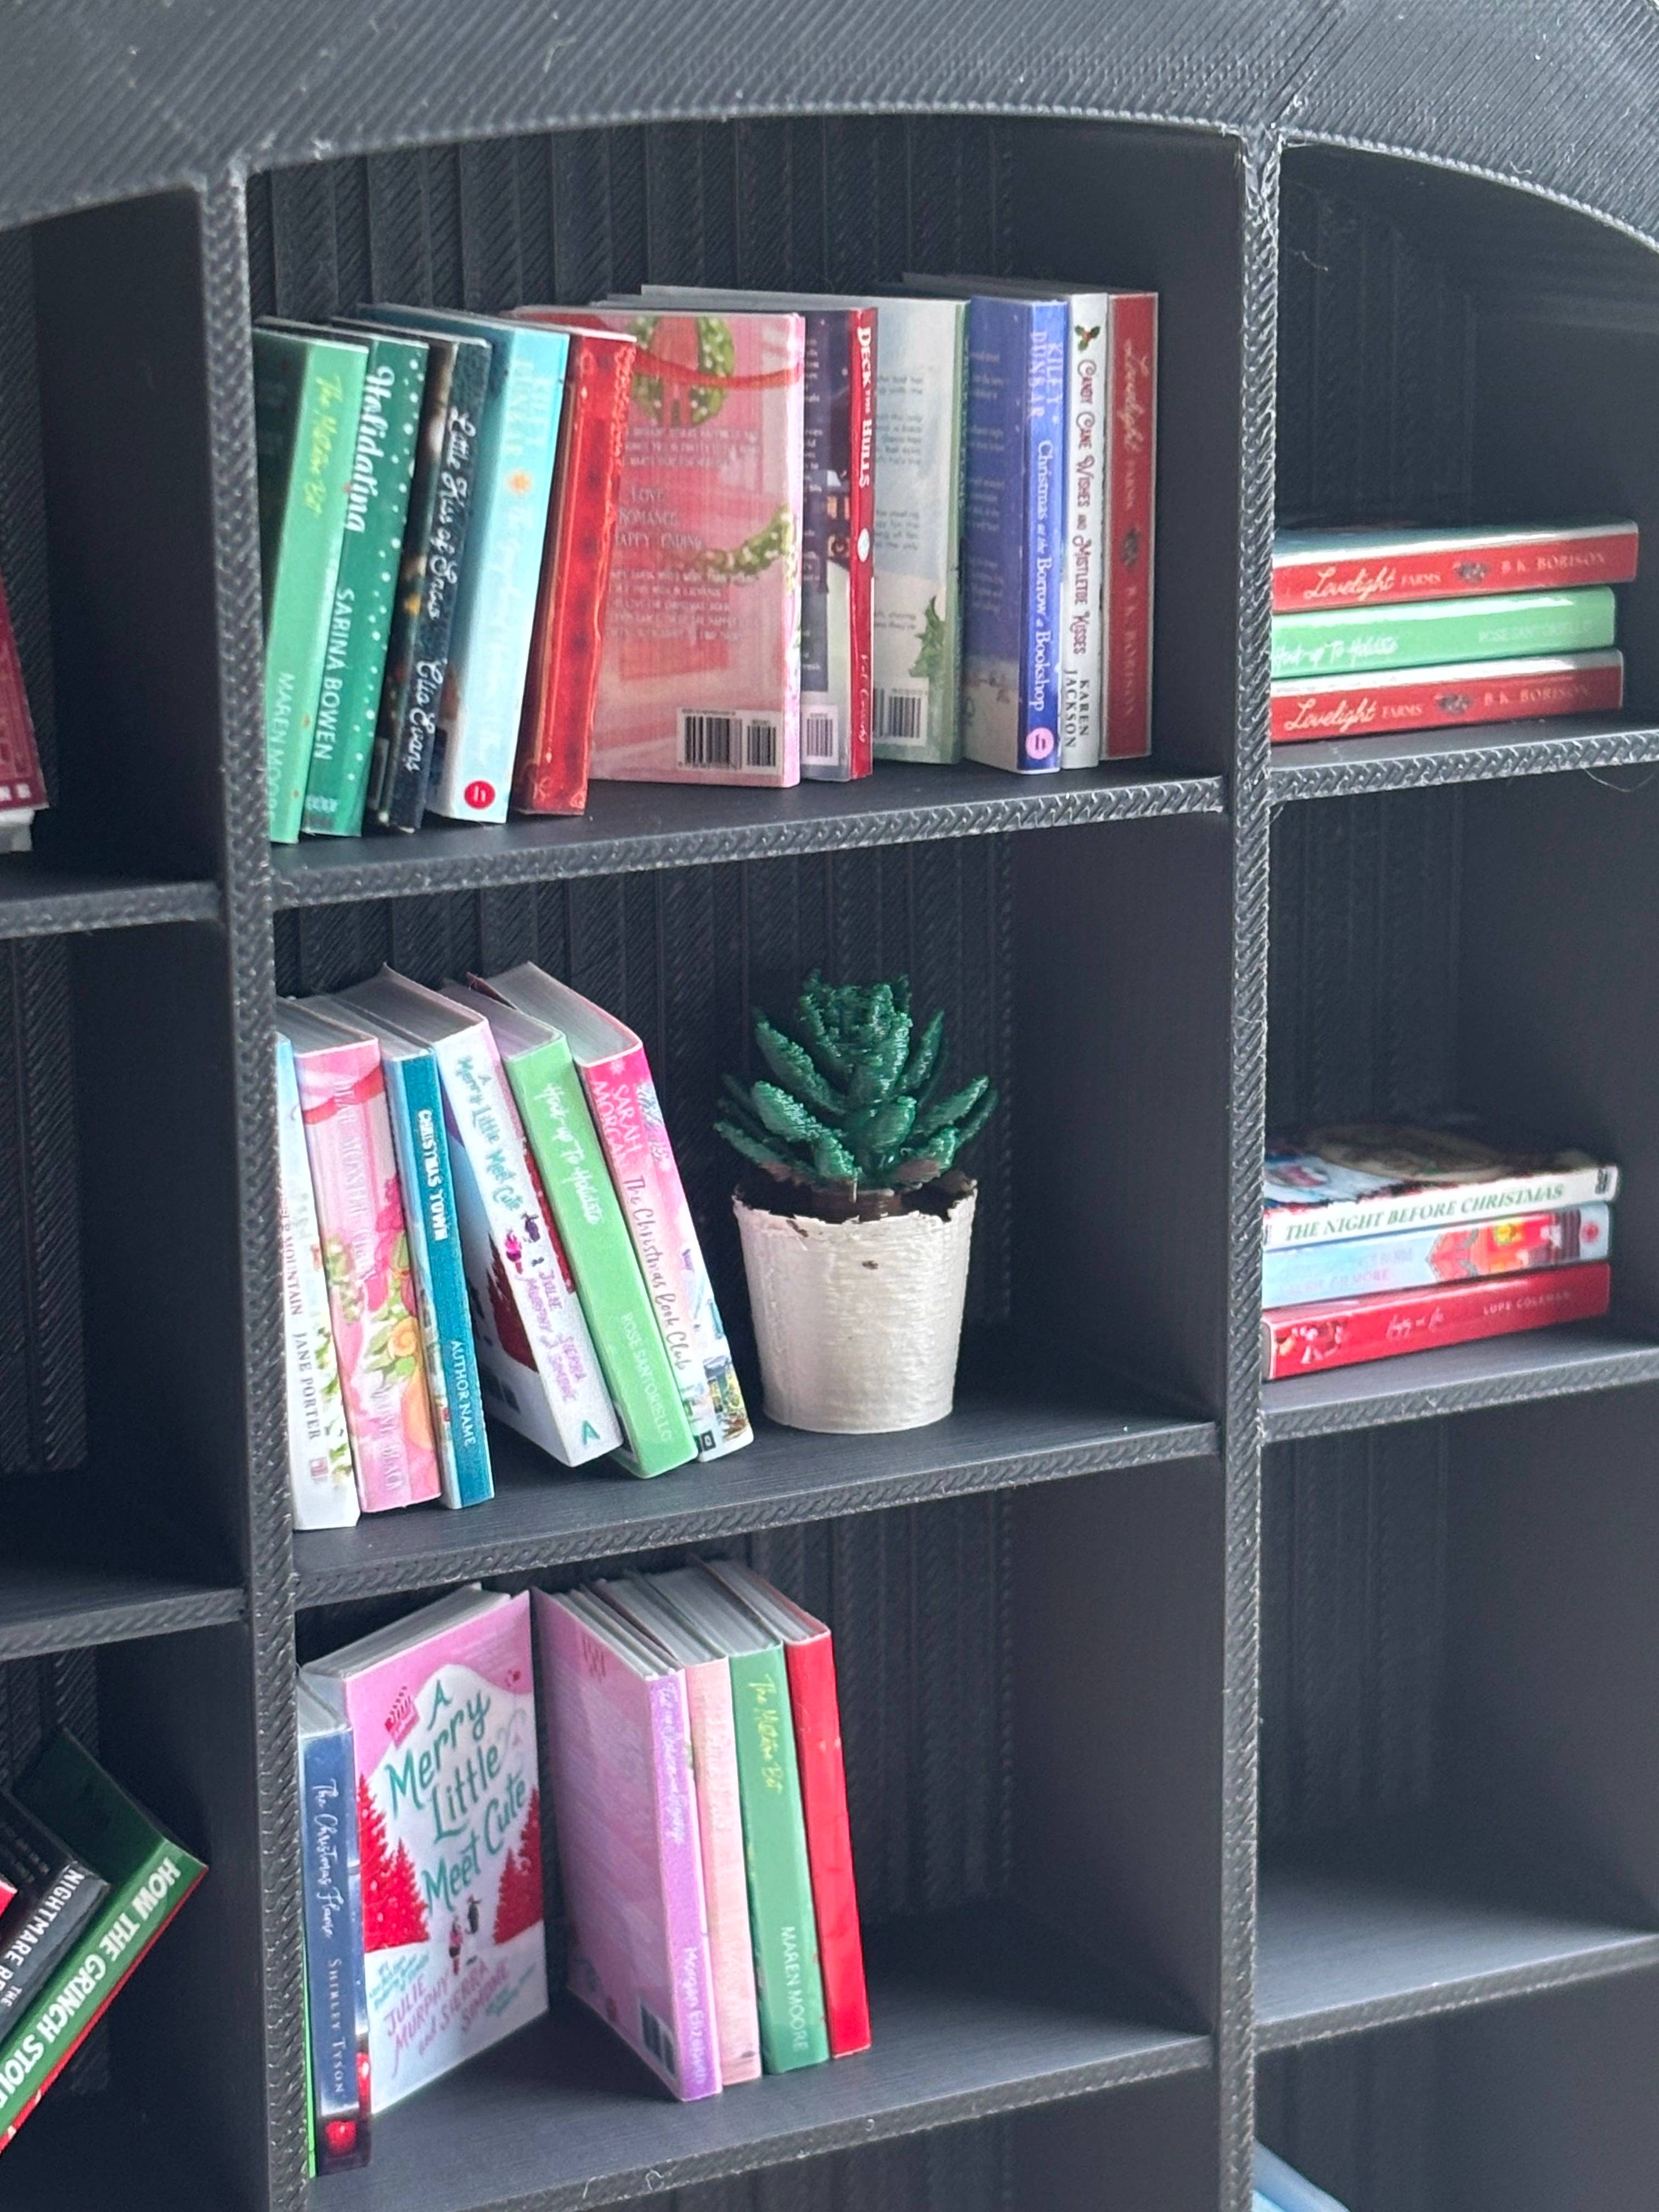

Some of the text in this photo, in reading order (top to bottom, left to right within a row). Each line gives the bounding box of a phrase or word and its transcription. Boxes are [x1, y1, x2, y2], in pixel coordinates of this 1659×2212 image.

[312, 373, 344, 407] The
[856, 326, 873, 387] DECK
[1043, 342, 1063, 406] KILEY
[857, 419, 872, 487] HULLS
[1034, 440, 1055, 520] Christmas
[421, 407, 478, 623] Little Kiss of Snow
[1035, 557, 1052, 614] Borrow
[1304, 562, 1395, 601] Lovelight
[1401, 572, 1441, 588] FARMS
[1537, 550, 1605, 569] BORISON
[325, 586, 355, 669] SARINA
[1324, 639, 1344, 658] To
[1028, 630, 1053, 711] Bookshop
[1076, 679, 1091, 736] KAREN
[269, 671, 296, 745] MAREN
[314, 676, 343, 760] BOWEN
[399, 656, 446, 774] Clio Evans
[1060, 670, 1080, 748] JACKSON
[1284, 697, 1375, 733] Lovelight
[1382, 704, 1423, 719] FARMS
[452, 1054, 526, 1215] Merry Little Meet Cute
[588, 1078, 633, 1165] MORGAN
[606, 1082, 648, 1153] SARAH
[416, 1108, 452, 1241] CHRISTMAS TOWN
[531, 1080, 606, 1230] Hook-up To Holidate
[1284, 1184, 1565, 1242] THE NIGHT BEFORE CHRISTMAS
[281, 1237, 303, 1316] MOUNTAIN
[538, 1268, 565, 1312] JULIE
[622, 1175, 696, 1373] The Christmas Book Club
[292, 1331, 313, 1372] JANE
[618, 1311, 674, 1443] ROSE SANTORIELLO
[300, 1377, 321, 1440] PORTER
[449, 1339, 477, 1449] AUTHOR NAME
[427, 1679, 453, 1732] A
[747, 1674, 776, 1705] The
[385, 1690, 492, 1820] Merry
[760, 1765, 785, 1794] Bet
[311, 1778, 340, 1808] The
[431, 1742, 501, 1844] Little
[313, 1813, 342, 1885] Christmas
[421, 1770, 527, 1914] Meet Cute
[4, 1867, 85, 1968] NIGHTMARE
[132, 1857, 182, 1921] HOW
[99, 1912, 141, 1962] THE
[36, 1953, 108, 2044] GRINCH
[383, 1973, 427, 2037] JULIE
[440, 1957, 488, 2031] SIERRA
[460, 1956, 509, 2033] SIMONE
[681, 1946, 702, 2008] Morgan
[780, 1926, 808, 2052] MAREN MOORE
[325, 1958, 349, 2094] SHIRLEY TYSON
[391, 1967, 450, 2080] MURPHY
